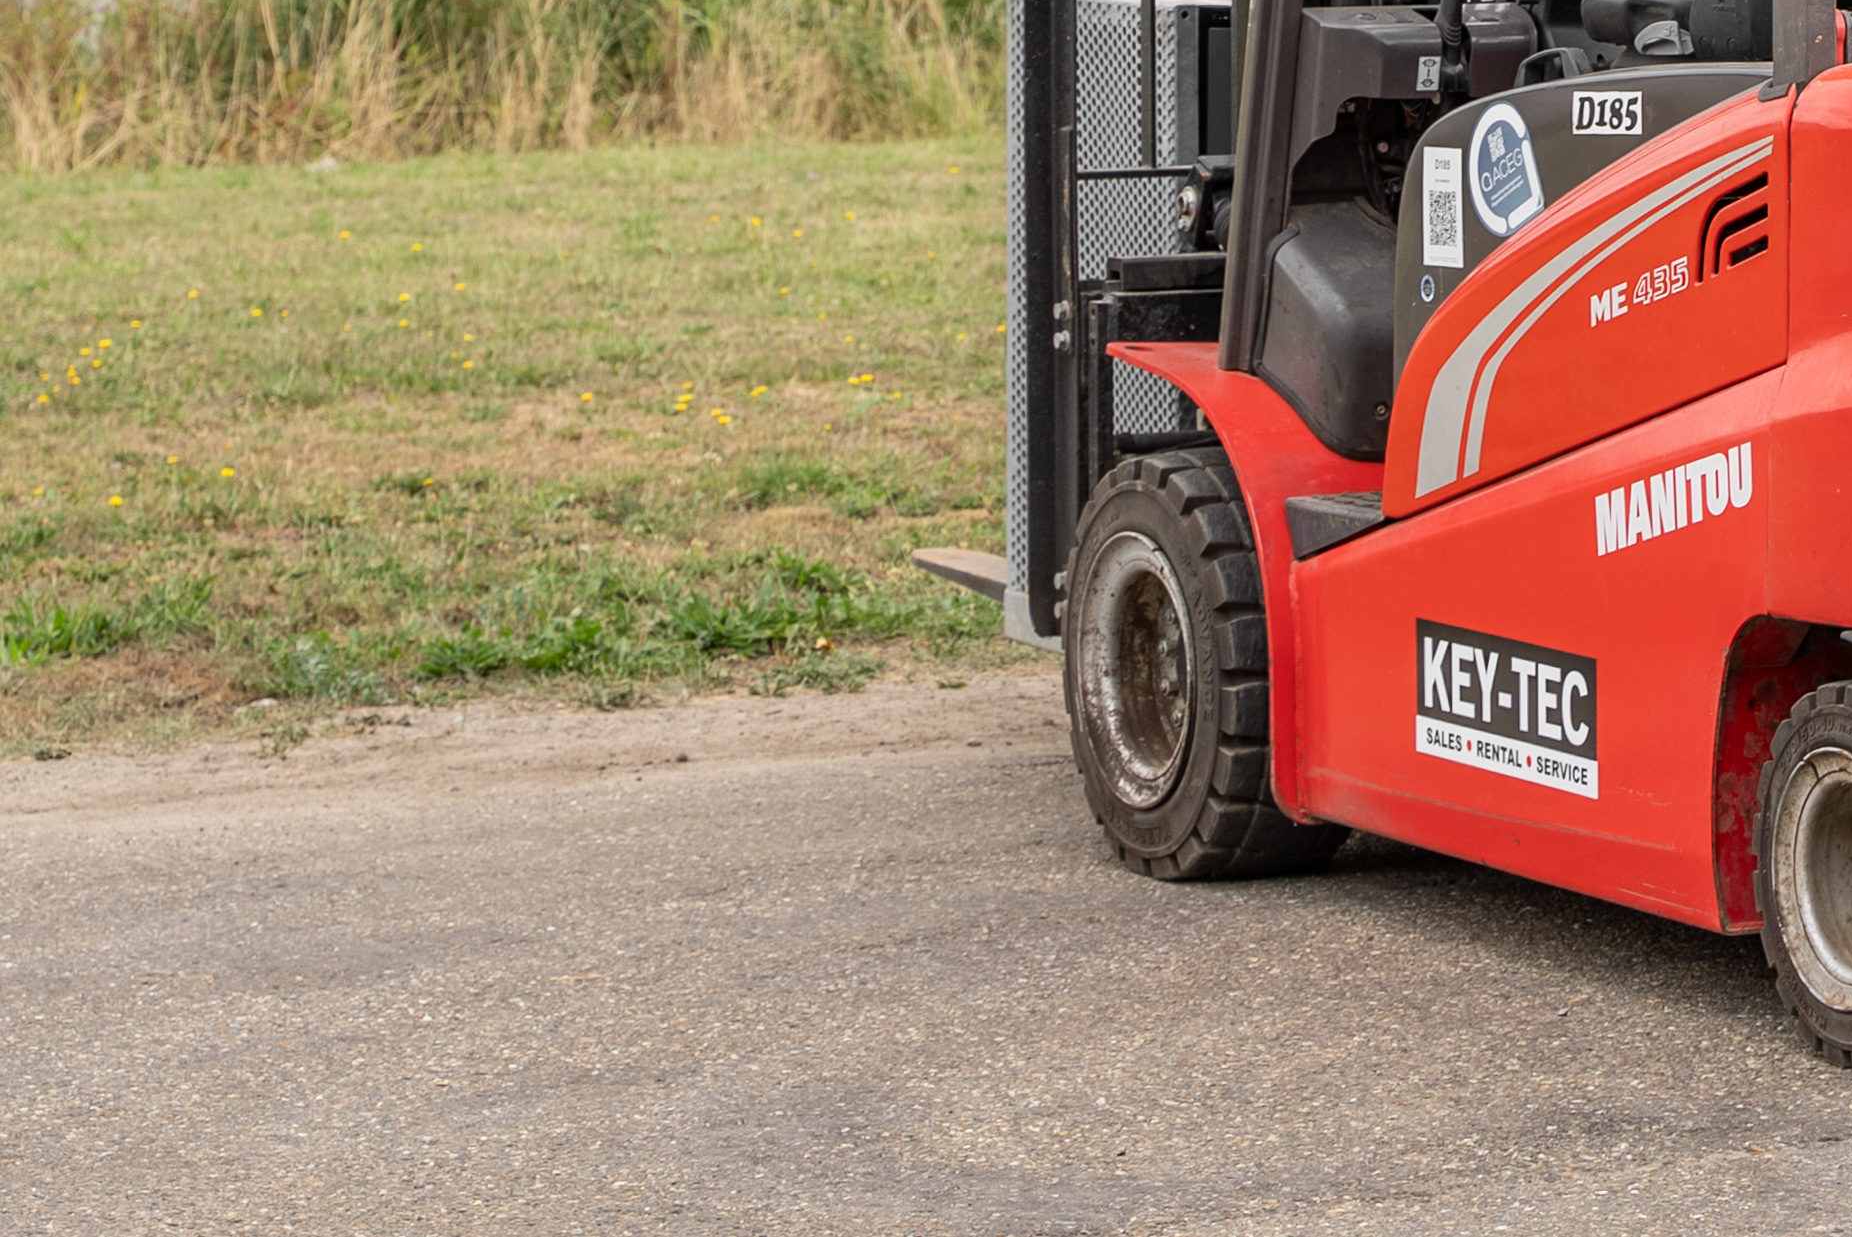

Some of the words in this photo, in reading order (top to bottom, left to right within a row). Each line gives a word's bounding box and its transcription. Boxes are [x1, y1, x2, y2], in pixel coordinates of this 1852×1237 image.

[1575, 95, 1640, 132] D185
[1590, 281, 1628, 328] ME
[1633, 256, 1689, 305] 435
[1595, 441, 1753, 557] MANITOU
[1422, 635, 1590, 747] KEY-TEC
[1425, 726, 1464, 752] SALES
[1475, 740, 1523, 769] RENTAL
[1535, 755, 1589, 786] SERVICE
